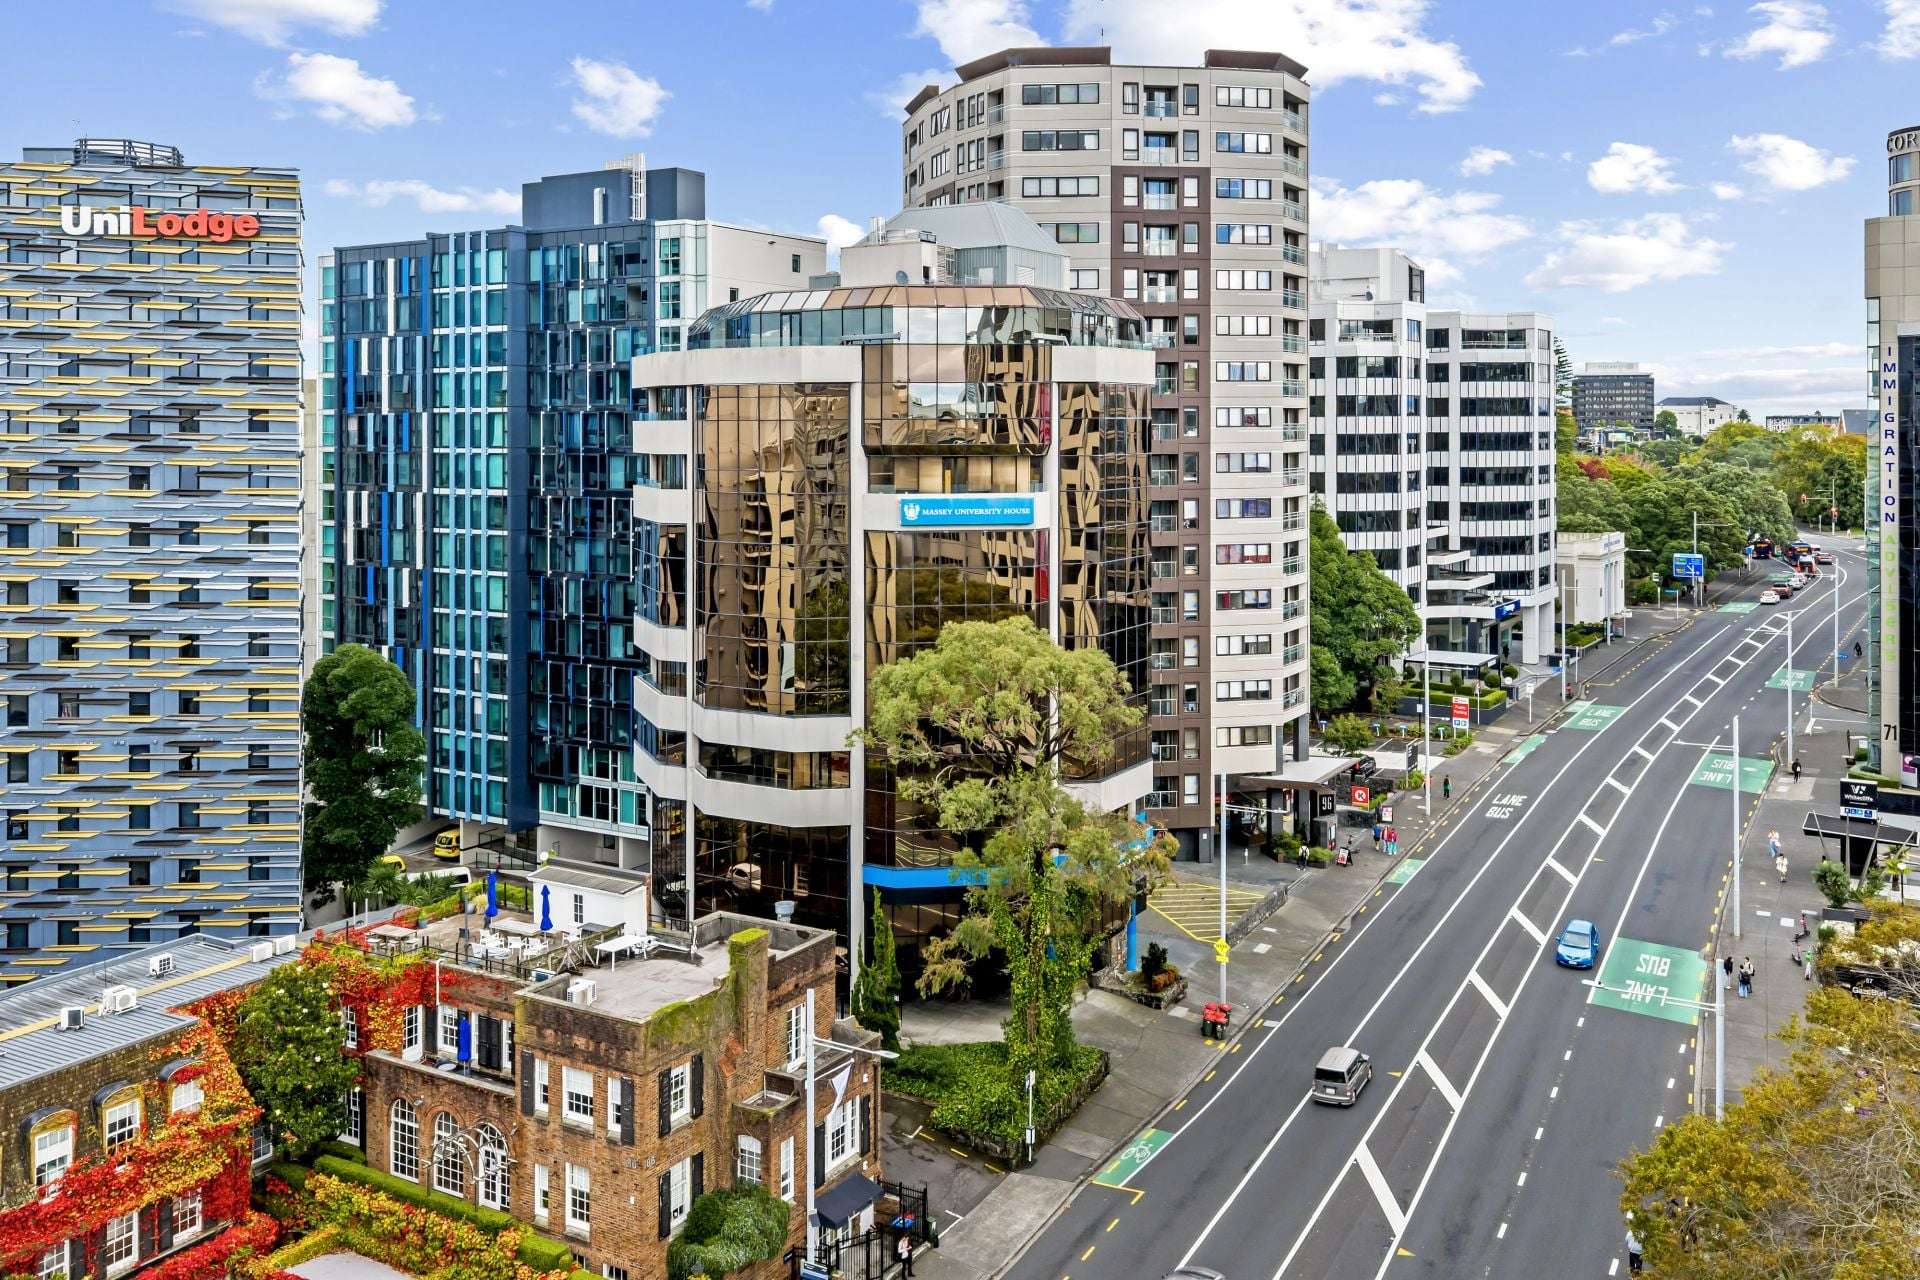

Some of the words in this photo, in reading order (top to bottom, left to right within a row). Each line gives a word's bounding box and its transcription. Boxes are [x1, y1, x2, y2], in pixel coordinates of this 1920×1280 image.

[61, 205, 260, 242] UniLodge
[1883, 346, 1897, 523] IMMIGRATION
[922, 508, 953, 516] MASSEY
[954, 508, 1002, 516] UNIVERSITY
[1003, 507, 1031, 515] HOUSE
[1884, 534, 1897, 661] ADVISERS
[1883, 724, 1897, 741] 71
[1699, 771, 1733, 784] LANE
[1322, 796, 1332, 810] 96
[1492, 793, 1528, 806] LANE
[1485, 806, 1514, 818] BUS
[1636, 953, 1671, 977] BUS
[1621, 979, 1669, 1007] LANE
